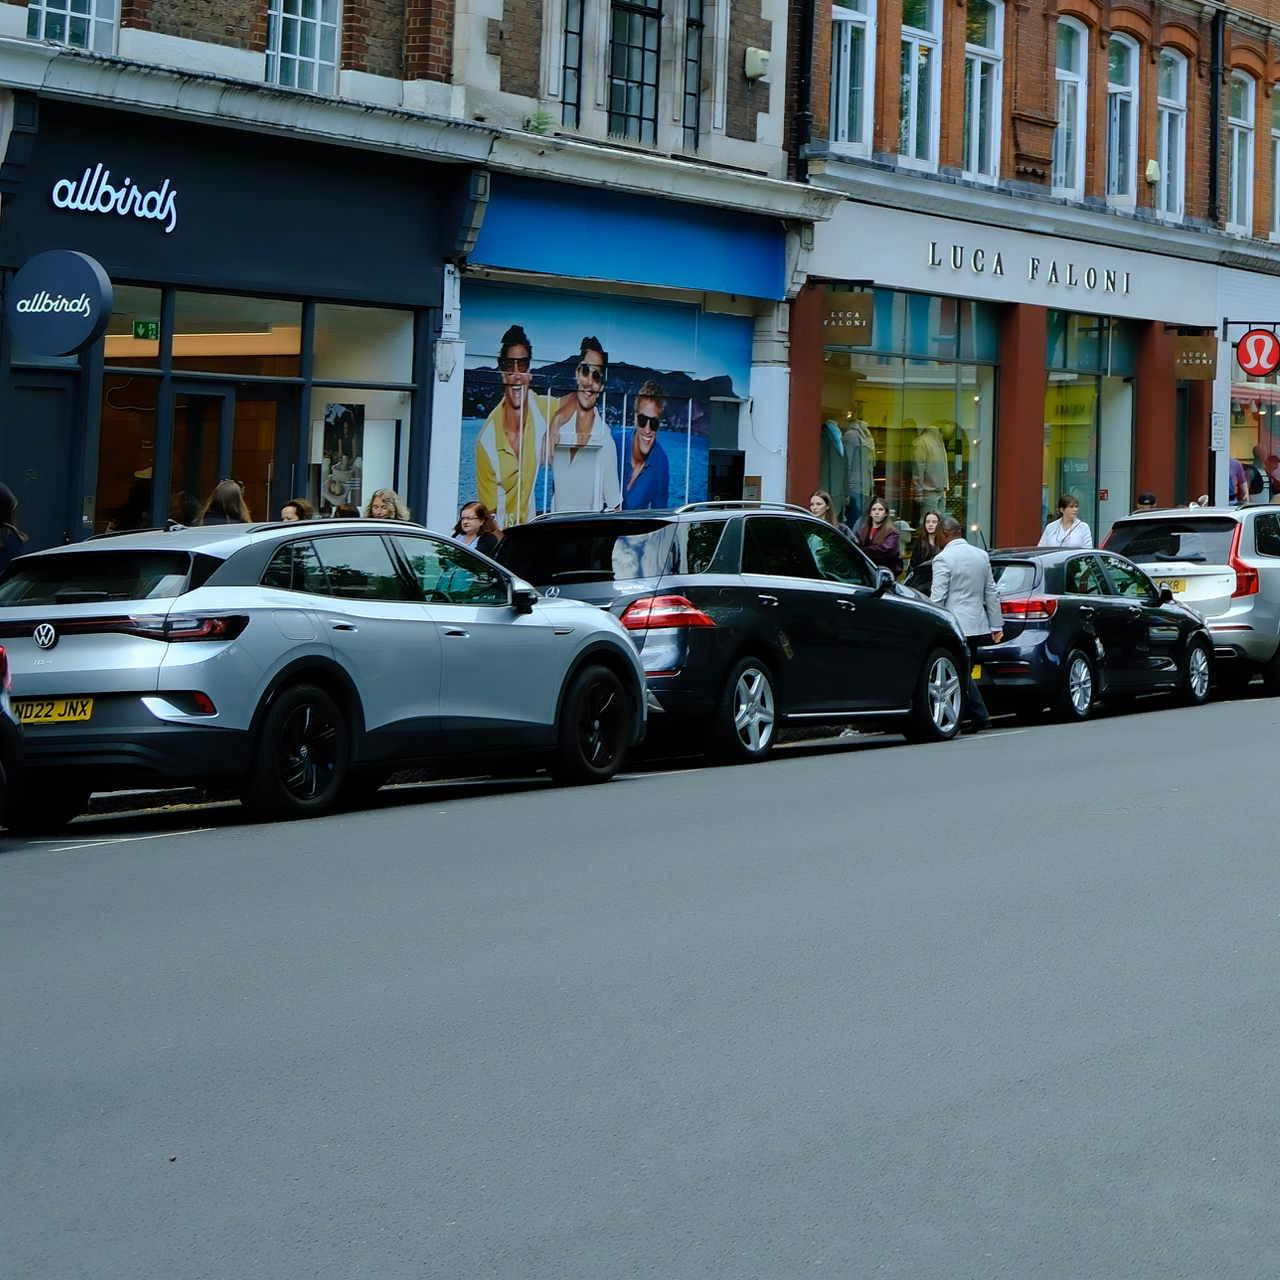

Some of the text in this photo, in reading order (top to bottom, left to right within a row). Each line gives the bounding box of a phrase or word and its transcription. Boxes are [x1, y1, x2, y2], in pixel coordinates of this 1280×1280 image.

[52, 162, 177, 233] allbirds
[928, 241, 1131, 296] LUCA FALONI
[16, 290, 91, 317] allbirds
[823, 319, 867, 327] FALONI
[14, 700, 89, 719] ND22 JNX
